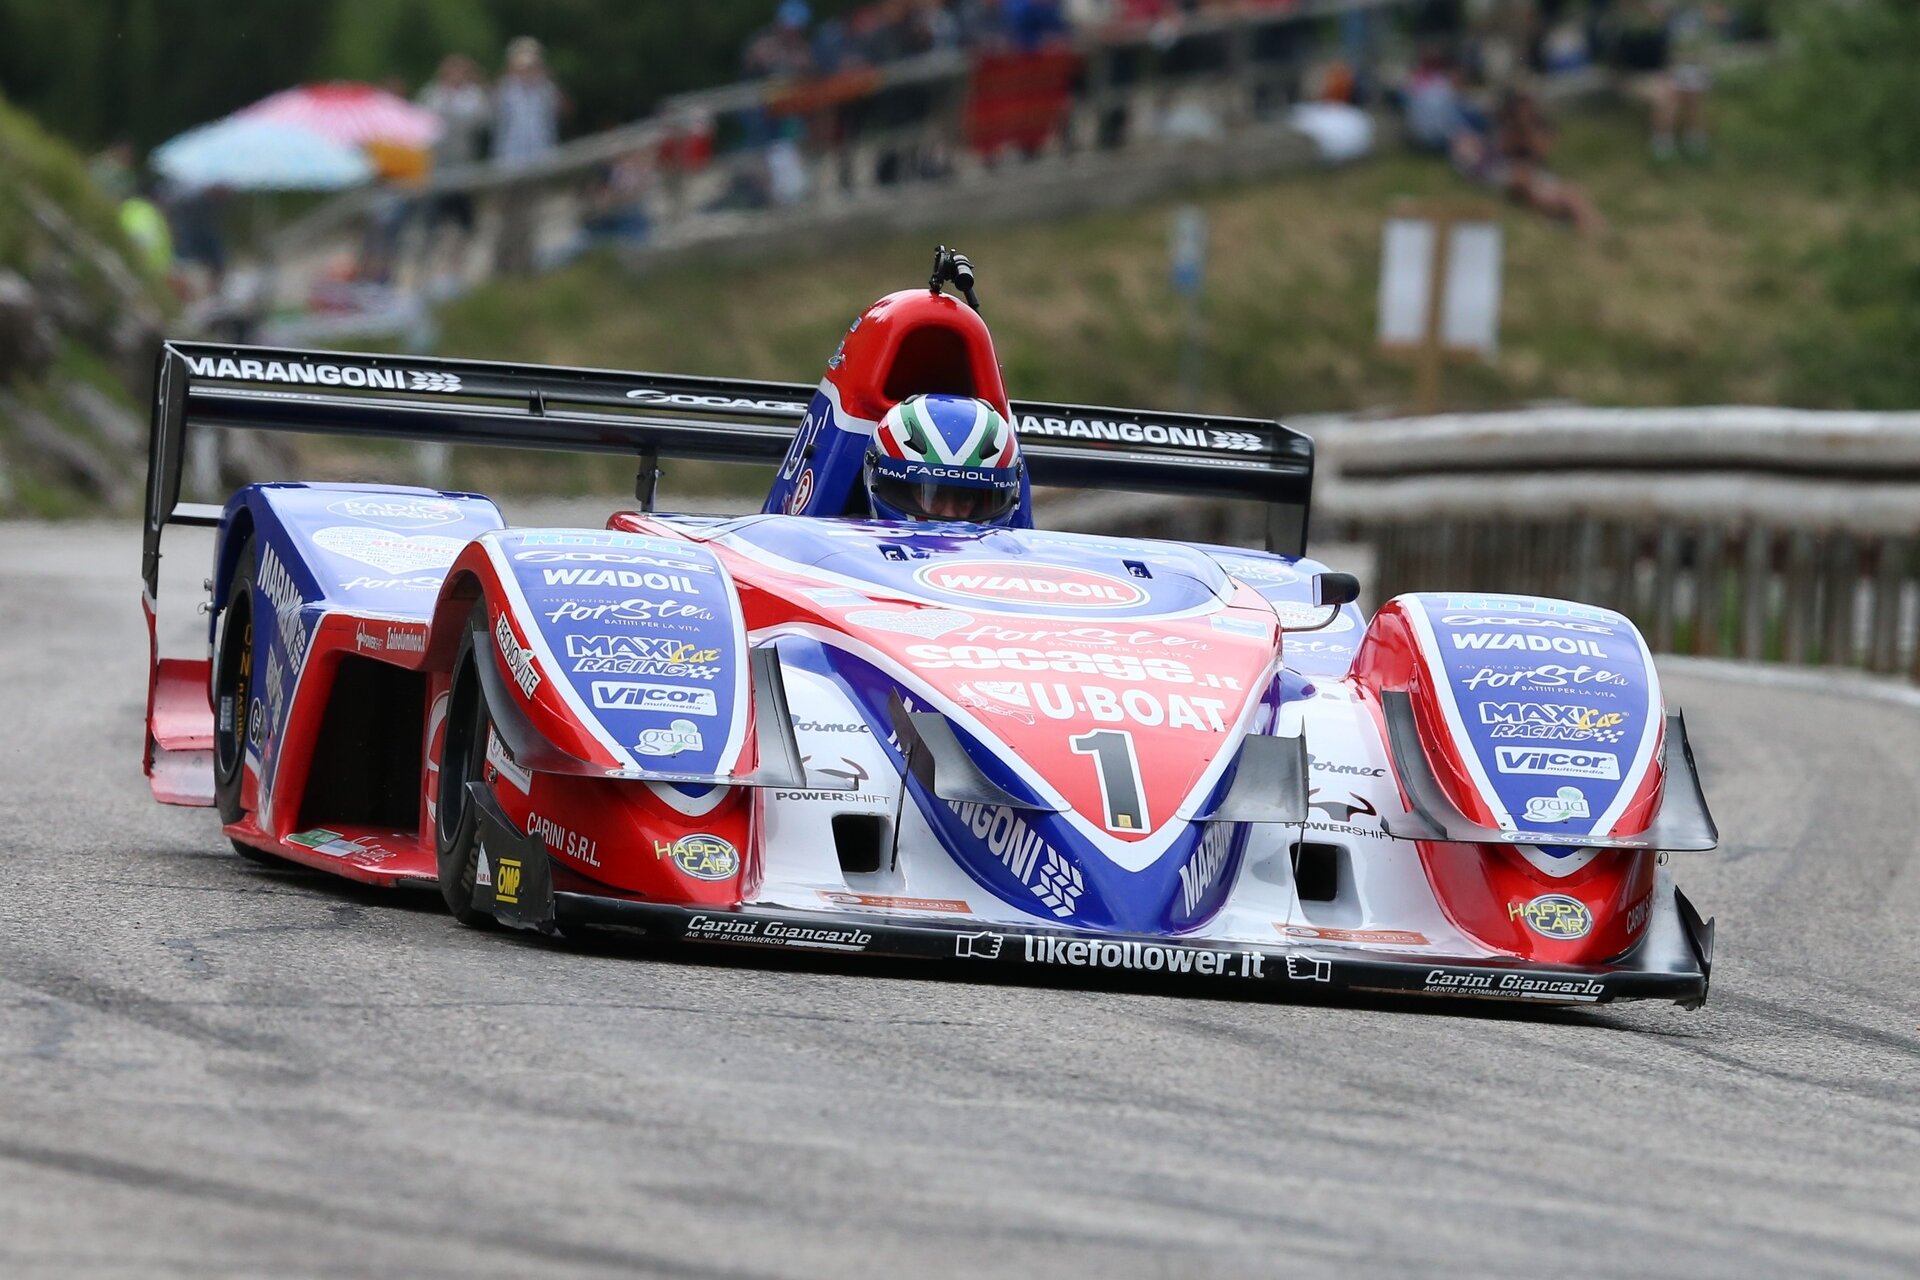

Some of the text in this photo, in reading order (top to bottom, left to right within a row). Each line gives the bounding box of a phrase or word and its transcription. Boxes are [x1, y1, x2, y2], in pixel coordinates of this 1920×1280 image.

[187, 356, 405, 389] MARANGONI
[877, 465, 1017, 489] TEAM FAGGIOLI TEAM
[514, 550, 716, 574] SOCAGE
[542, 569, 700, 594] WLADOIL
[939, 574, 1128, 601] WLADOIL
[605, 619, 639, 627] BATTITI
[679, 625, 700, 633] VITA
[1441, 615, 1614, 635] SOCAGE
[565, 635, 685, 661] MAXI
[1451, 633, 1608, 658] WLADOIL
[572, 658, 690, 677] RACING
[598, 687, 705, 705] Vilcor
[1521, 685, 1556, 693] BATTITI
[1594, 691, 1617, 699] VITA
[1479, 702, 1590, 726] MAXI
[1490, 724, 1597, 741] RACING
[1502, 752, 1608, 769] Vilcor
[1069, 728, 1151, 834] 1
[775, 792, 890, 804] POWERSHIFT
[527, 812, 601, 867] CARINI S.R.L.
[1284, 821, 1398, 842] POWERSHIFT
[654, 840, 734, 860] HAPPY
[684, 856, 733, 876] CAR
[498, 866, 520, 895] OMP
[1508, 902, 1585, 922] HAPPY
[688, 915, 872, 944] Carini Giancarlo
[1536, 917, 1585, 936] CAR
[731, 935, 785, 945] COMMERCIO
[1024, 934, 1266, 979] likefollower.it
[1425, 970, 1605, 994] Carini Giancarlo
